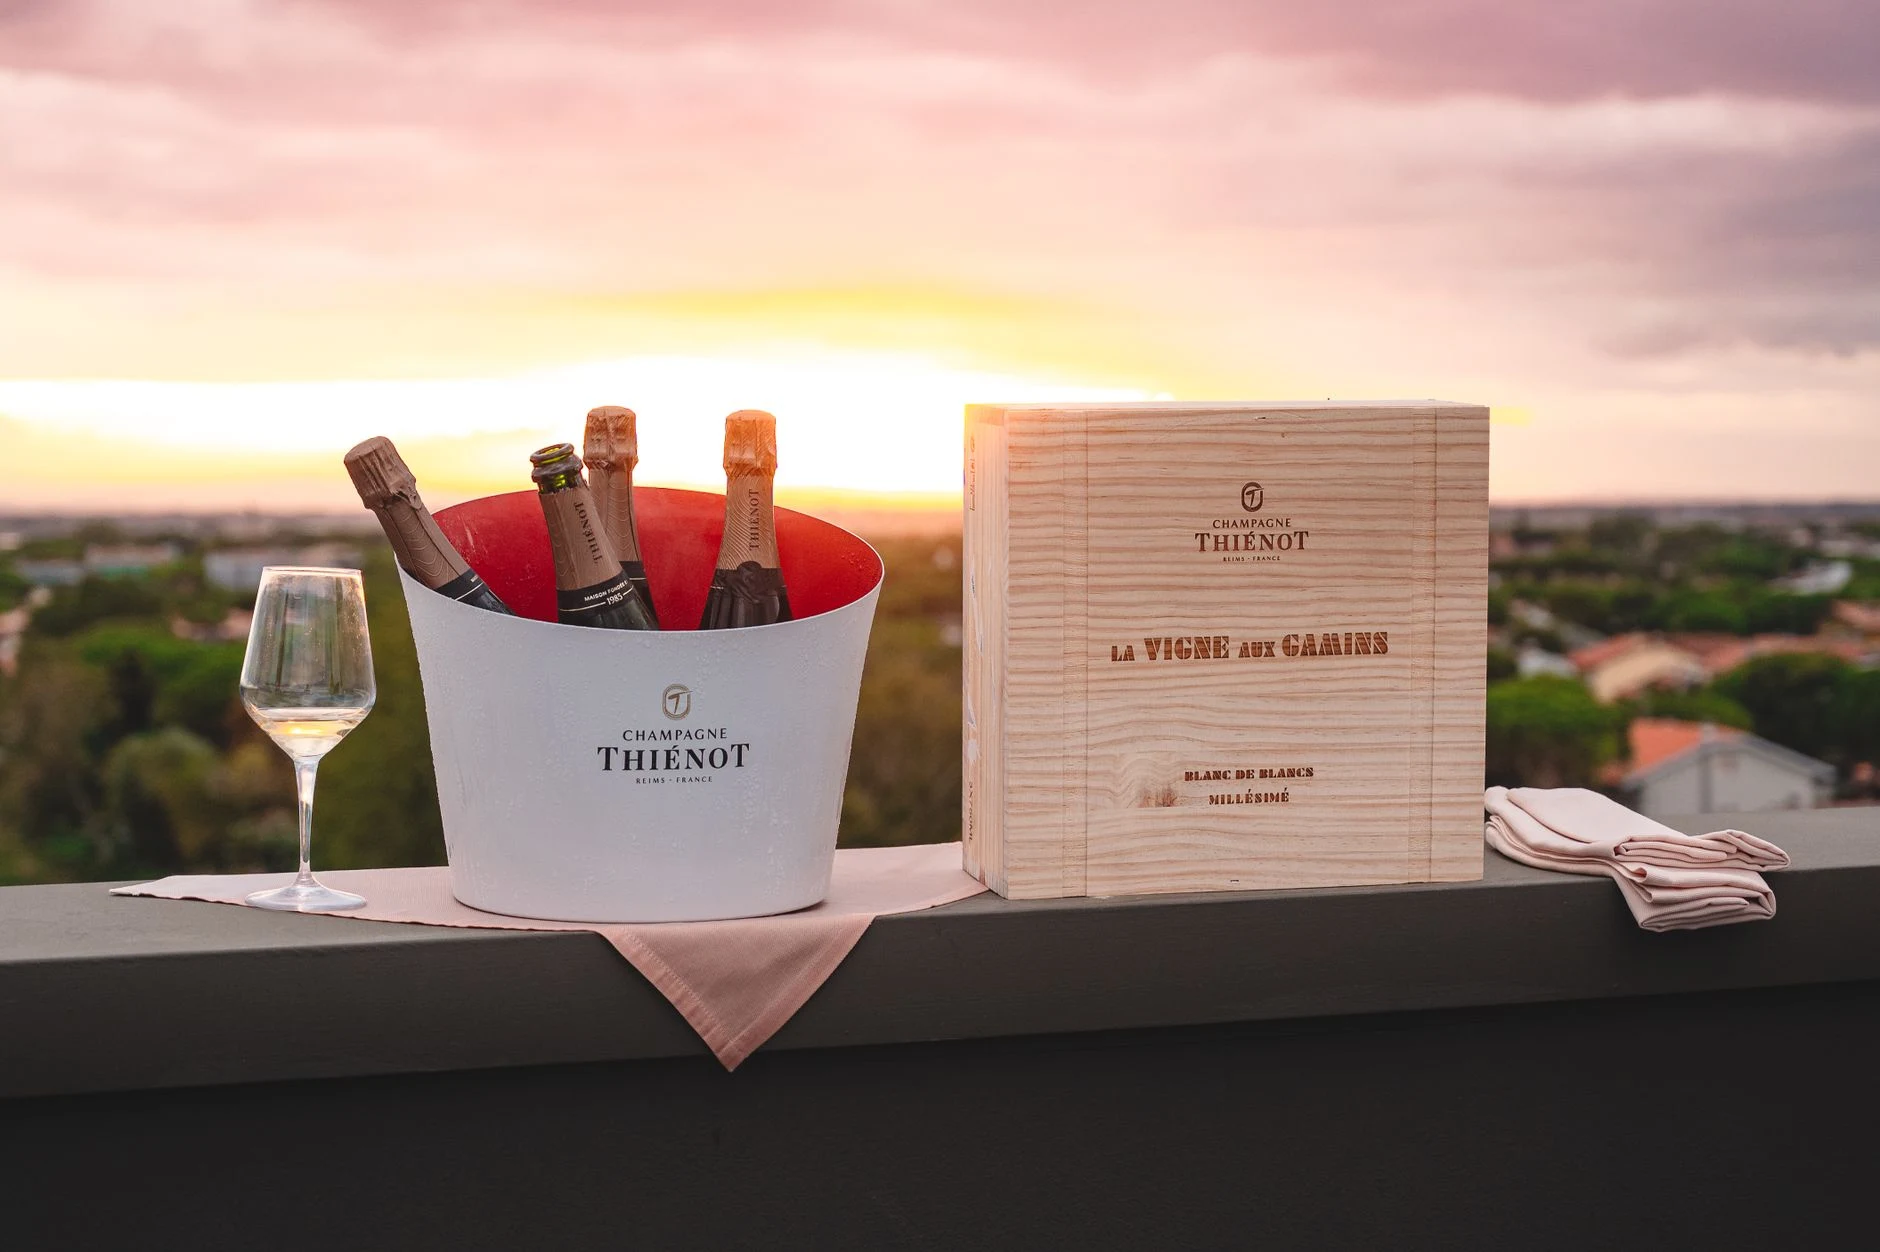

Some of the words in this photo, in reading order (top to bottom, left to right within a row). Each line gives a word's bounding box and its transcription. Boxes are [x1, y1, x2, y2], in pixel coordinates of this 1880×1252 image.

[1212, 517, 1292, 529] CHAMPAGNE
[1194, 530, 1310, 553] THIÉNOT
[584, 591, 607, 602] MAISON
[606, 592, 623, 606] 1985
[1111, 645, 1136, 662] LA
[1143, 635, 1230, 661] VIGNE
[1238, 641, 1276, 659] AUX
[1281, 631, 1389, 657] GAMINS
[622, 727, 728, 742] CHAMPAGNE
[596, 742, 750, 771] THIÉNOT
[1184, 770, 1232, 782] BLANC
[1235, 769, 1255, 780] DE
[1258, 767, 1315, 779] BLANCS
[1208, 787, 1290, 806] MILLÉSIMÉ
